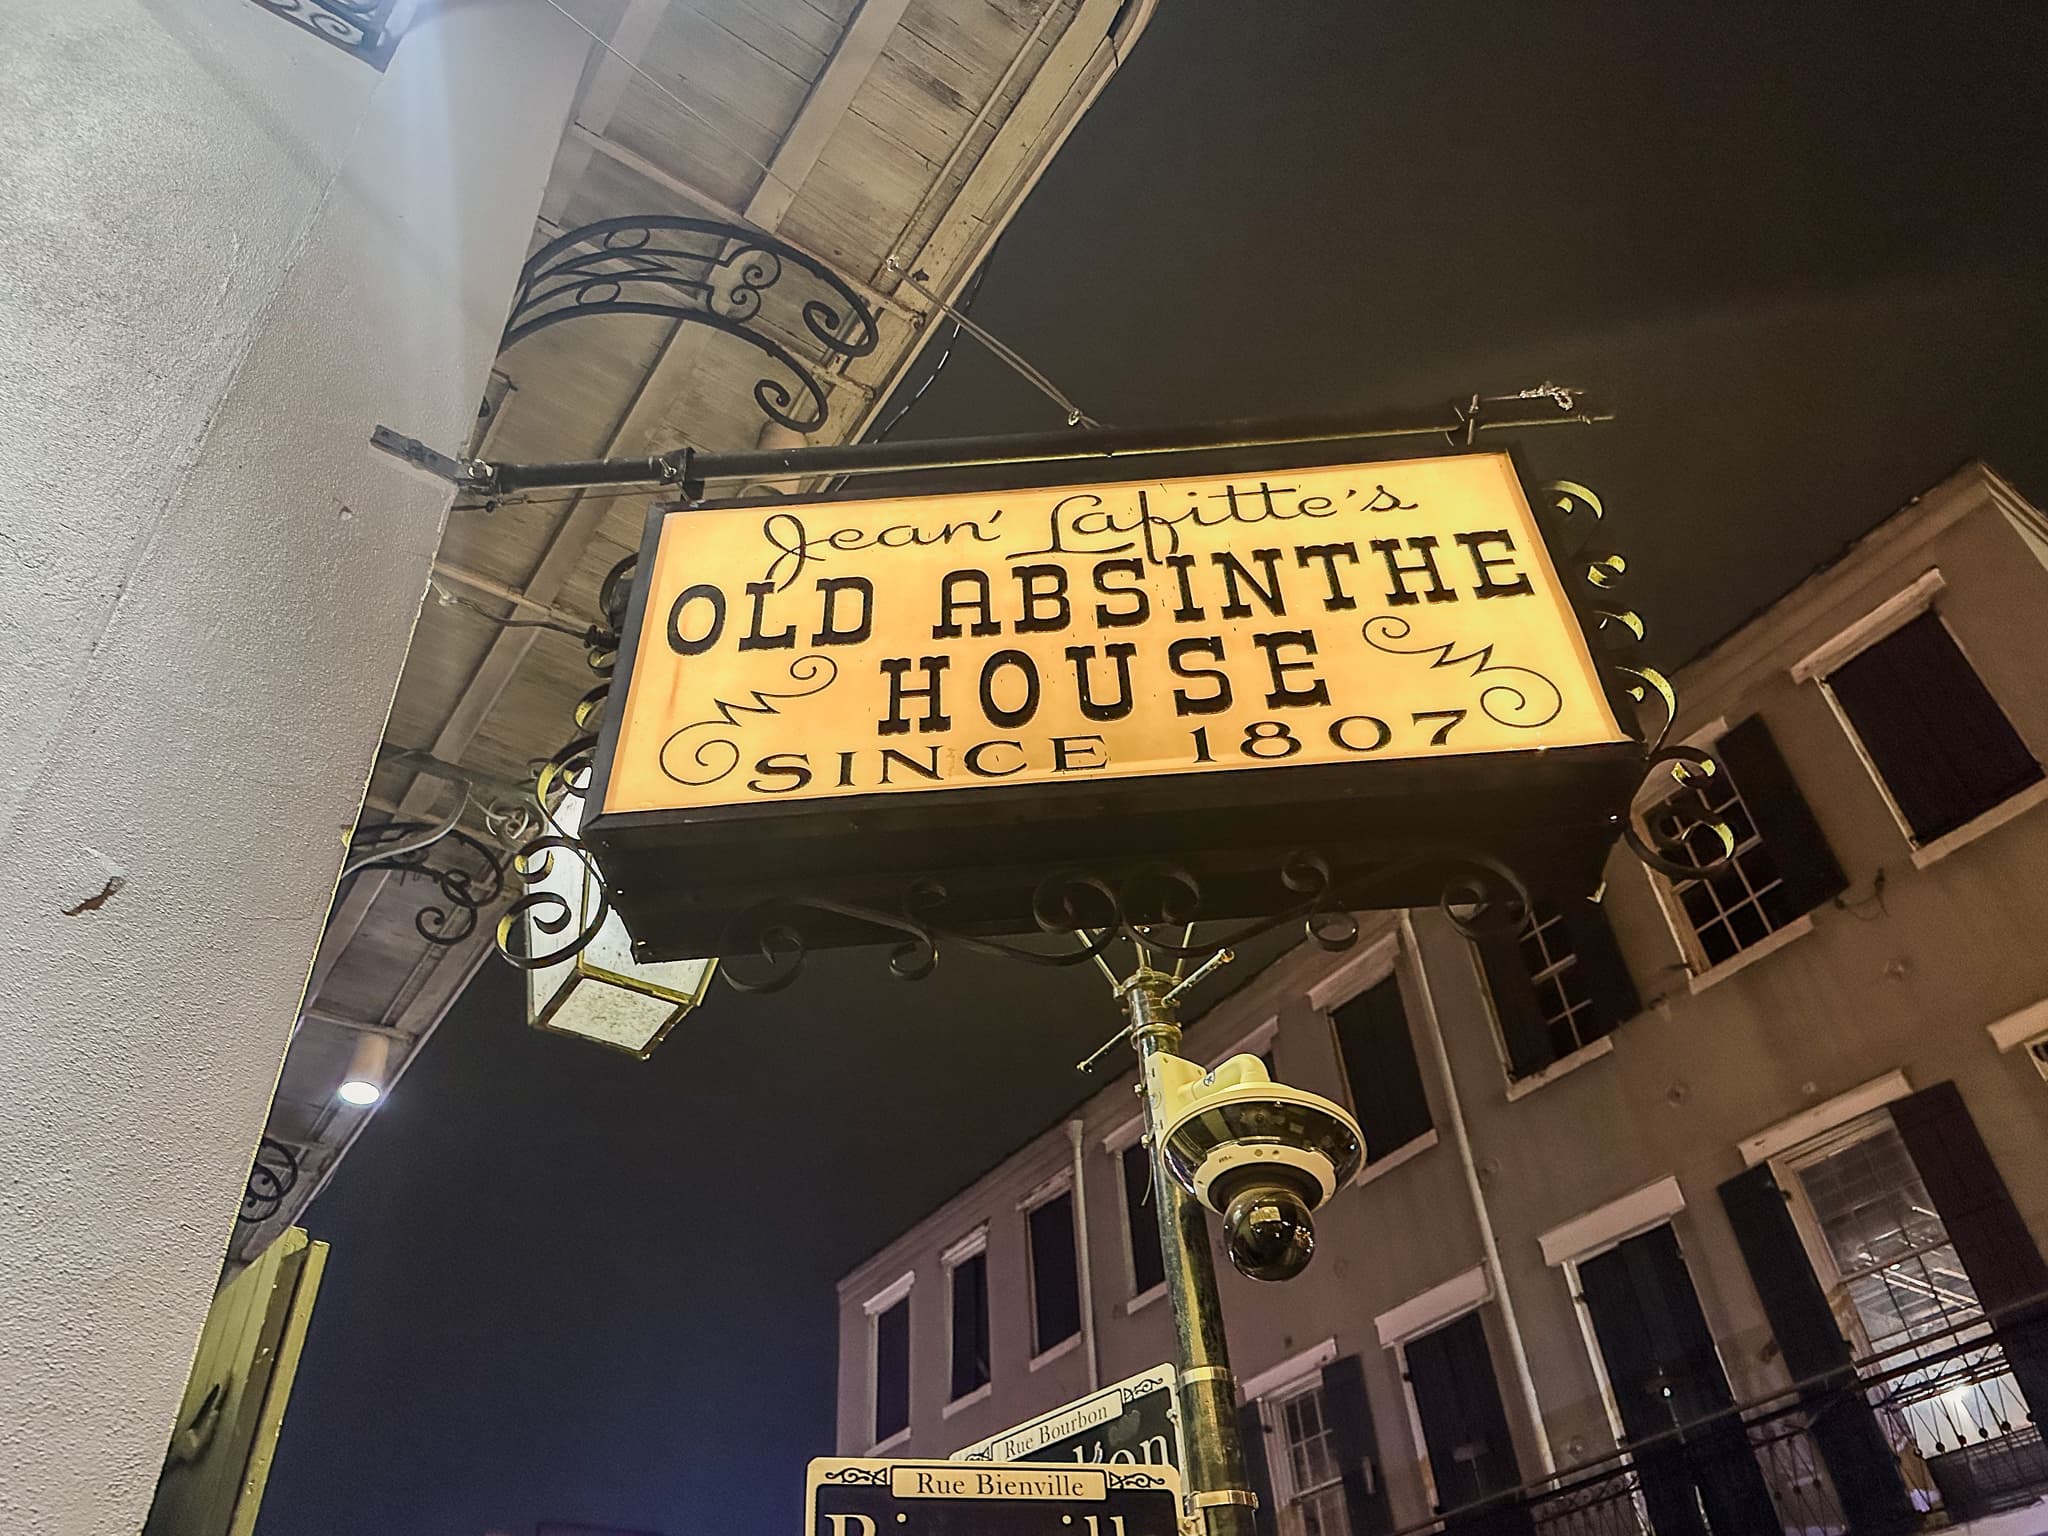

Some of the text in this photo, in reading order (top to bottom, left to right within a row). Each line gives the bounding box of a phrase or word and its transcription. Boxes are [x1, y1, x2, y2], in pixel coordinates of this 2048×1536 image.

[1005, 481, 1419, 564] Lafitte's
[666, 528, 1535, 656] OLD ABSINTHE
[877, 629, 1332, 736] HOUSE
[746, 708, 1468, 794] SINCE 1807
[1004, 1406, 1108, 1459] Rue Bourbon
[916, 1472, 1085, 1498] Rue Bienville
